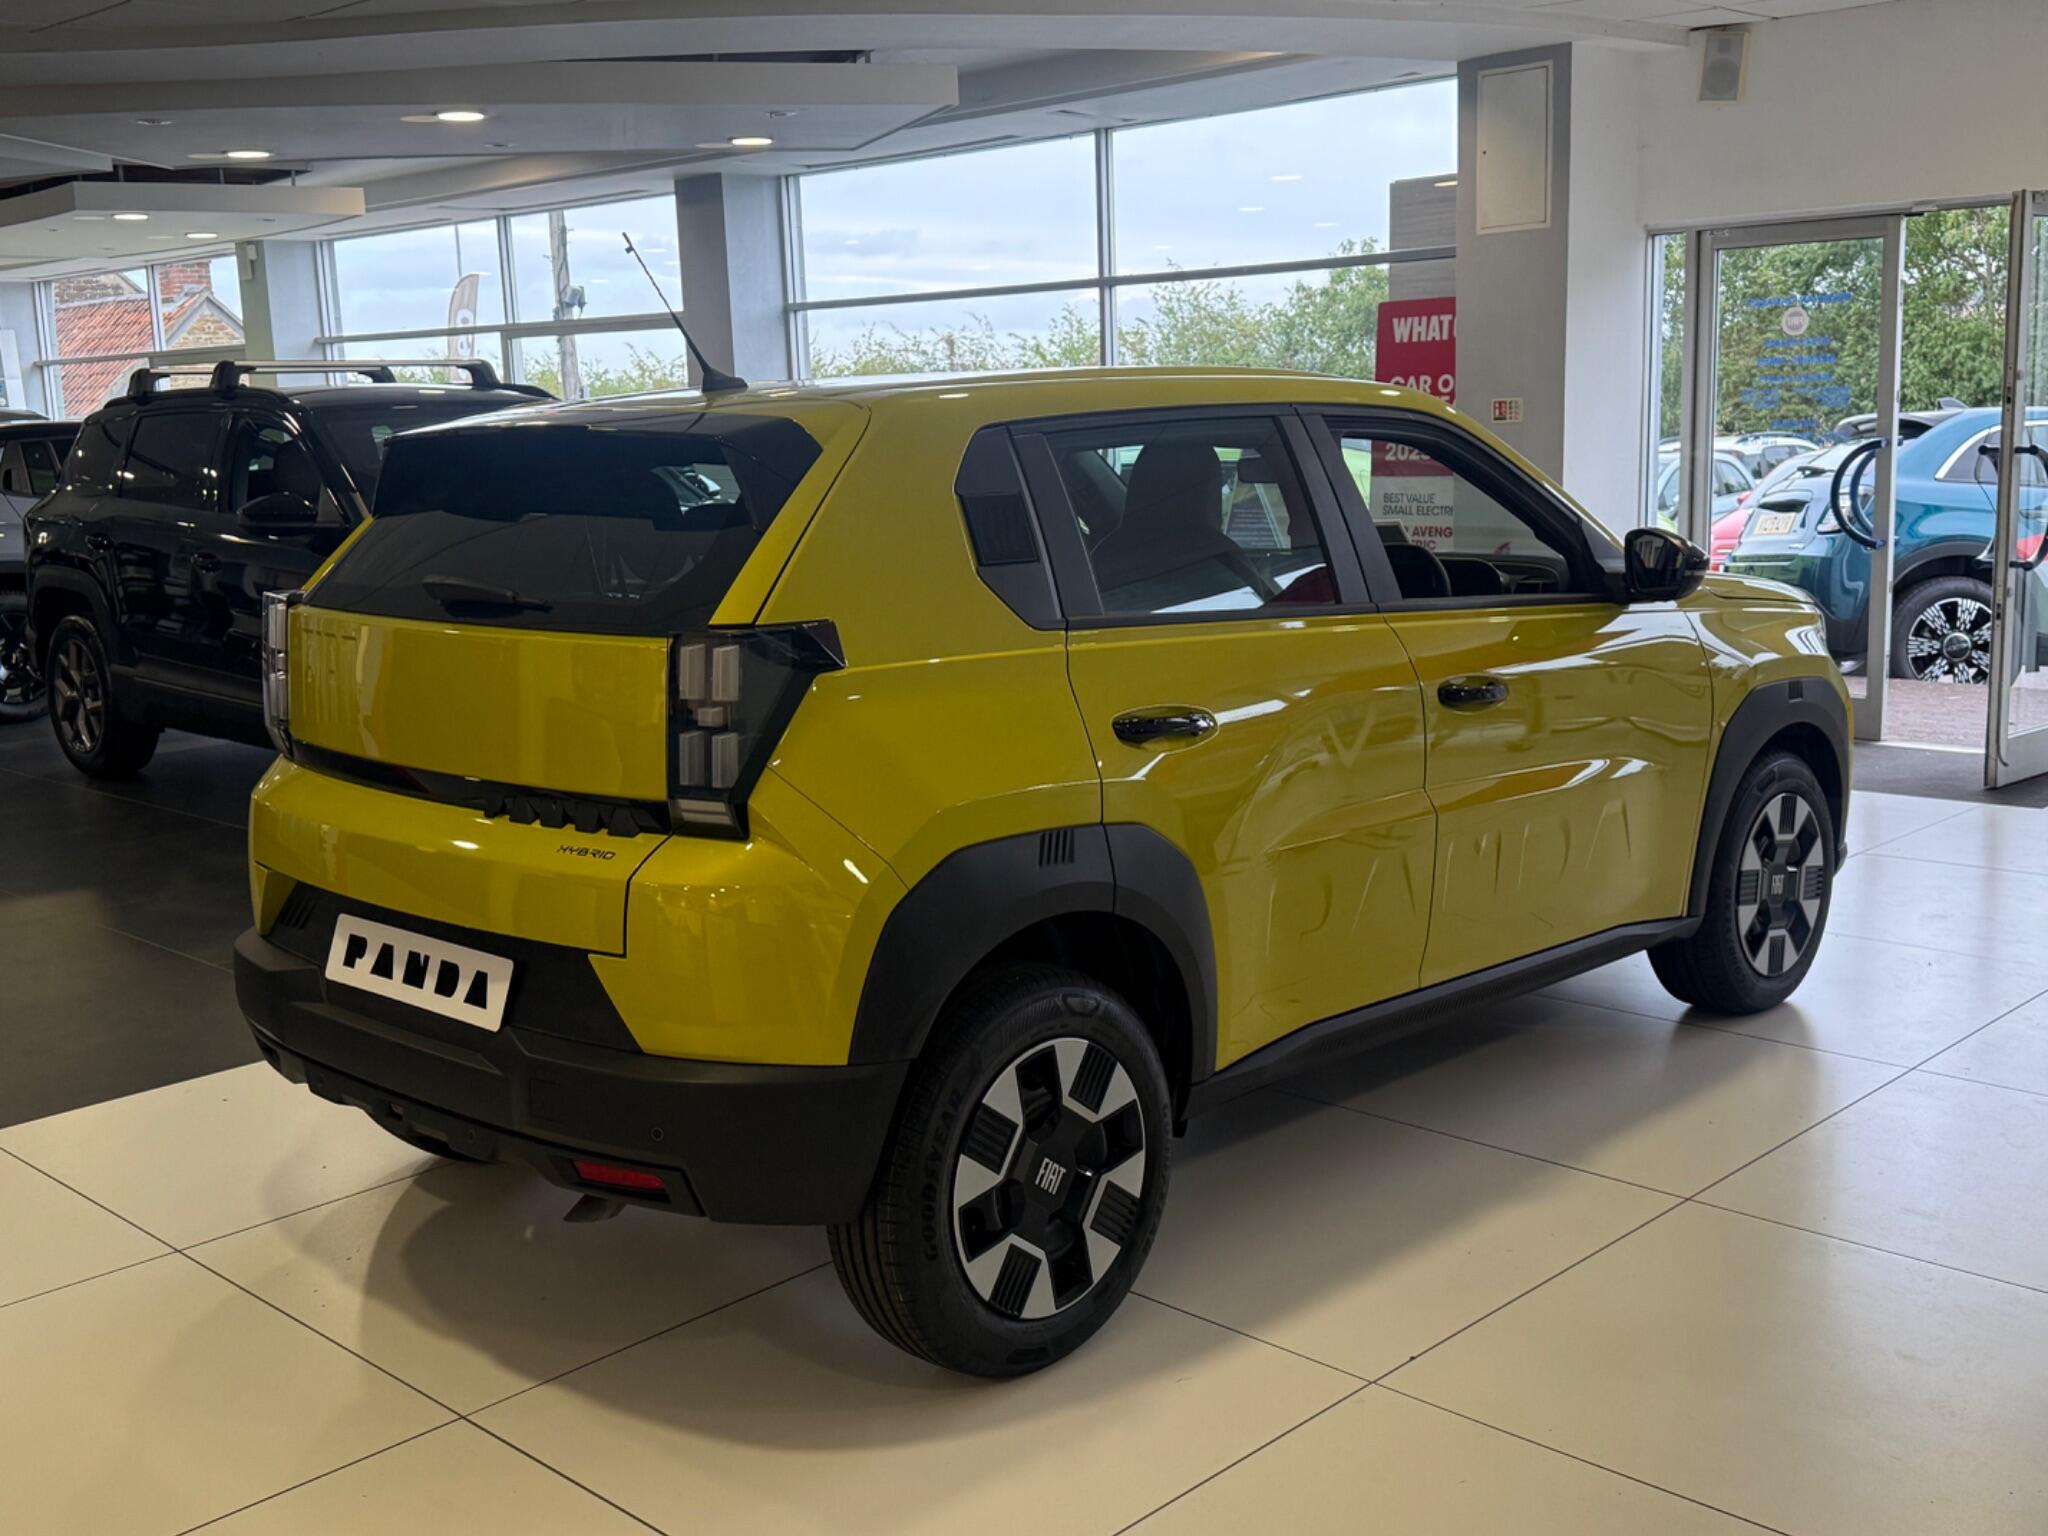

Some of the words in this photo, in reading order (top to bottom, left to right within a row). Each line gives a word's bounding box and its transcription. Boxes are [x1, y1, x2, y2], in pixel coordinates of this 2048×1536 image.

[1392, 314, 1456, 343] WHAT
[1383, 493, 1404, 503] BEST
[1406, 493, 1435, 504] VALUE
[1382, 505, 1413, 515] SMALL
[557, 845, 616, 860] HYBRID
[342, 933, 488, 1010] PANDA
[1035, 1157, 1066, 1195] FIAT
